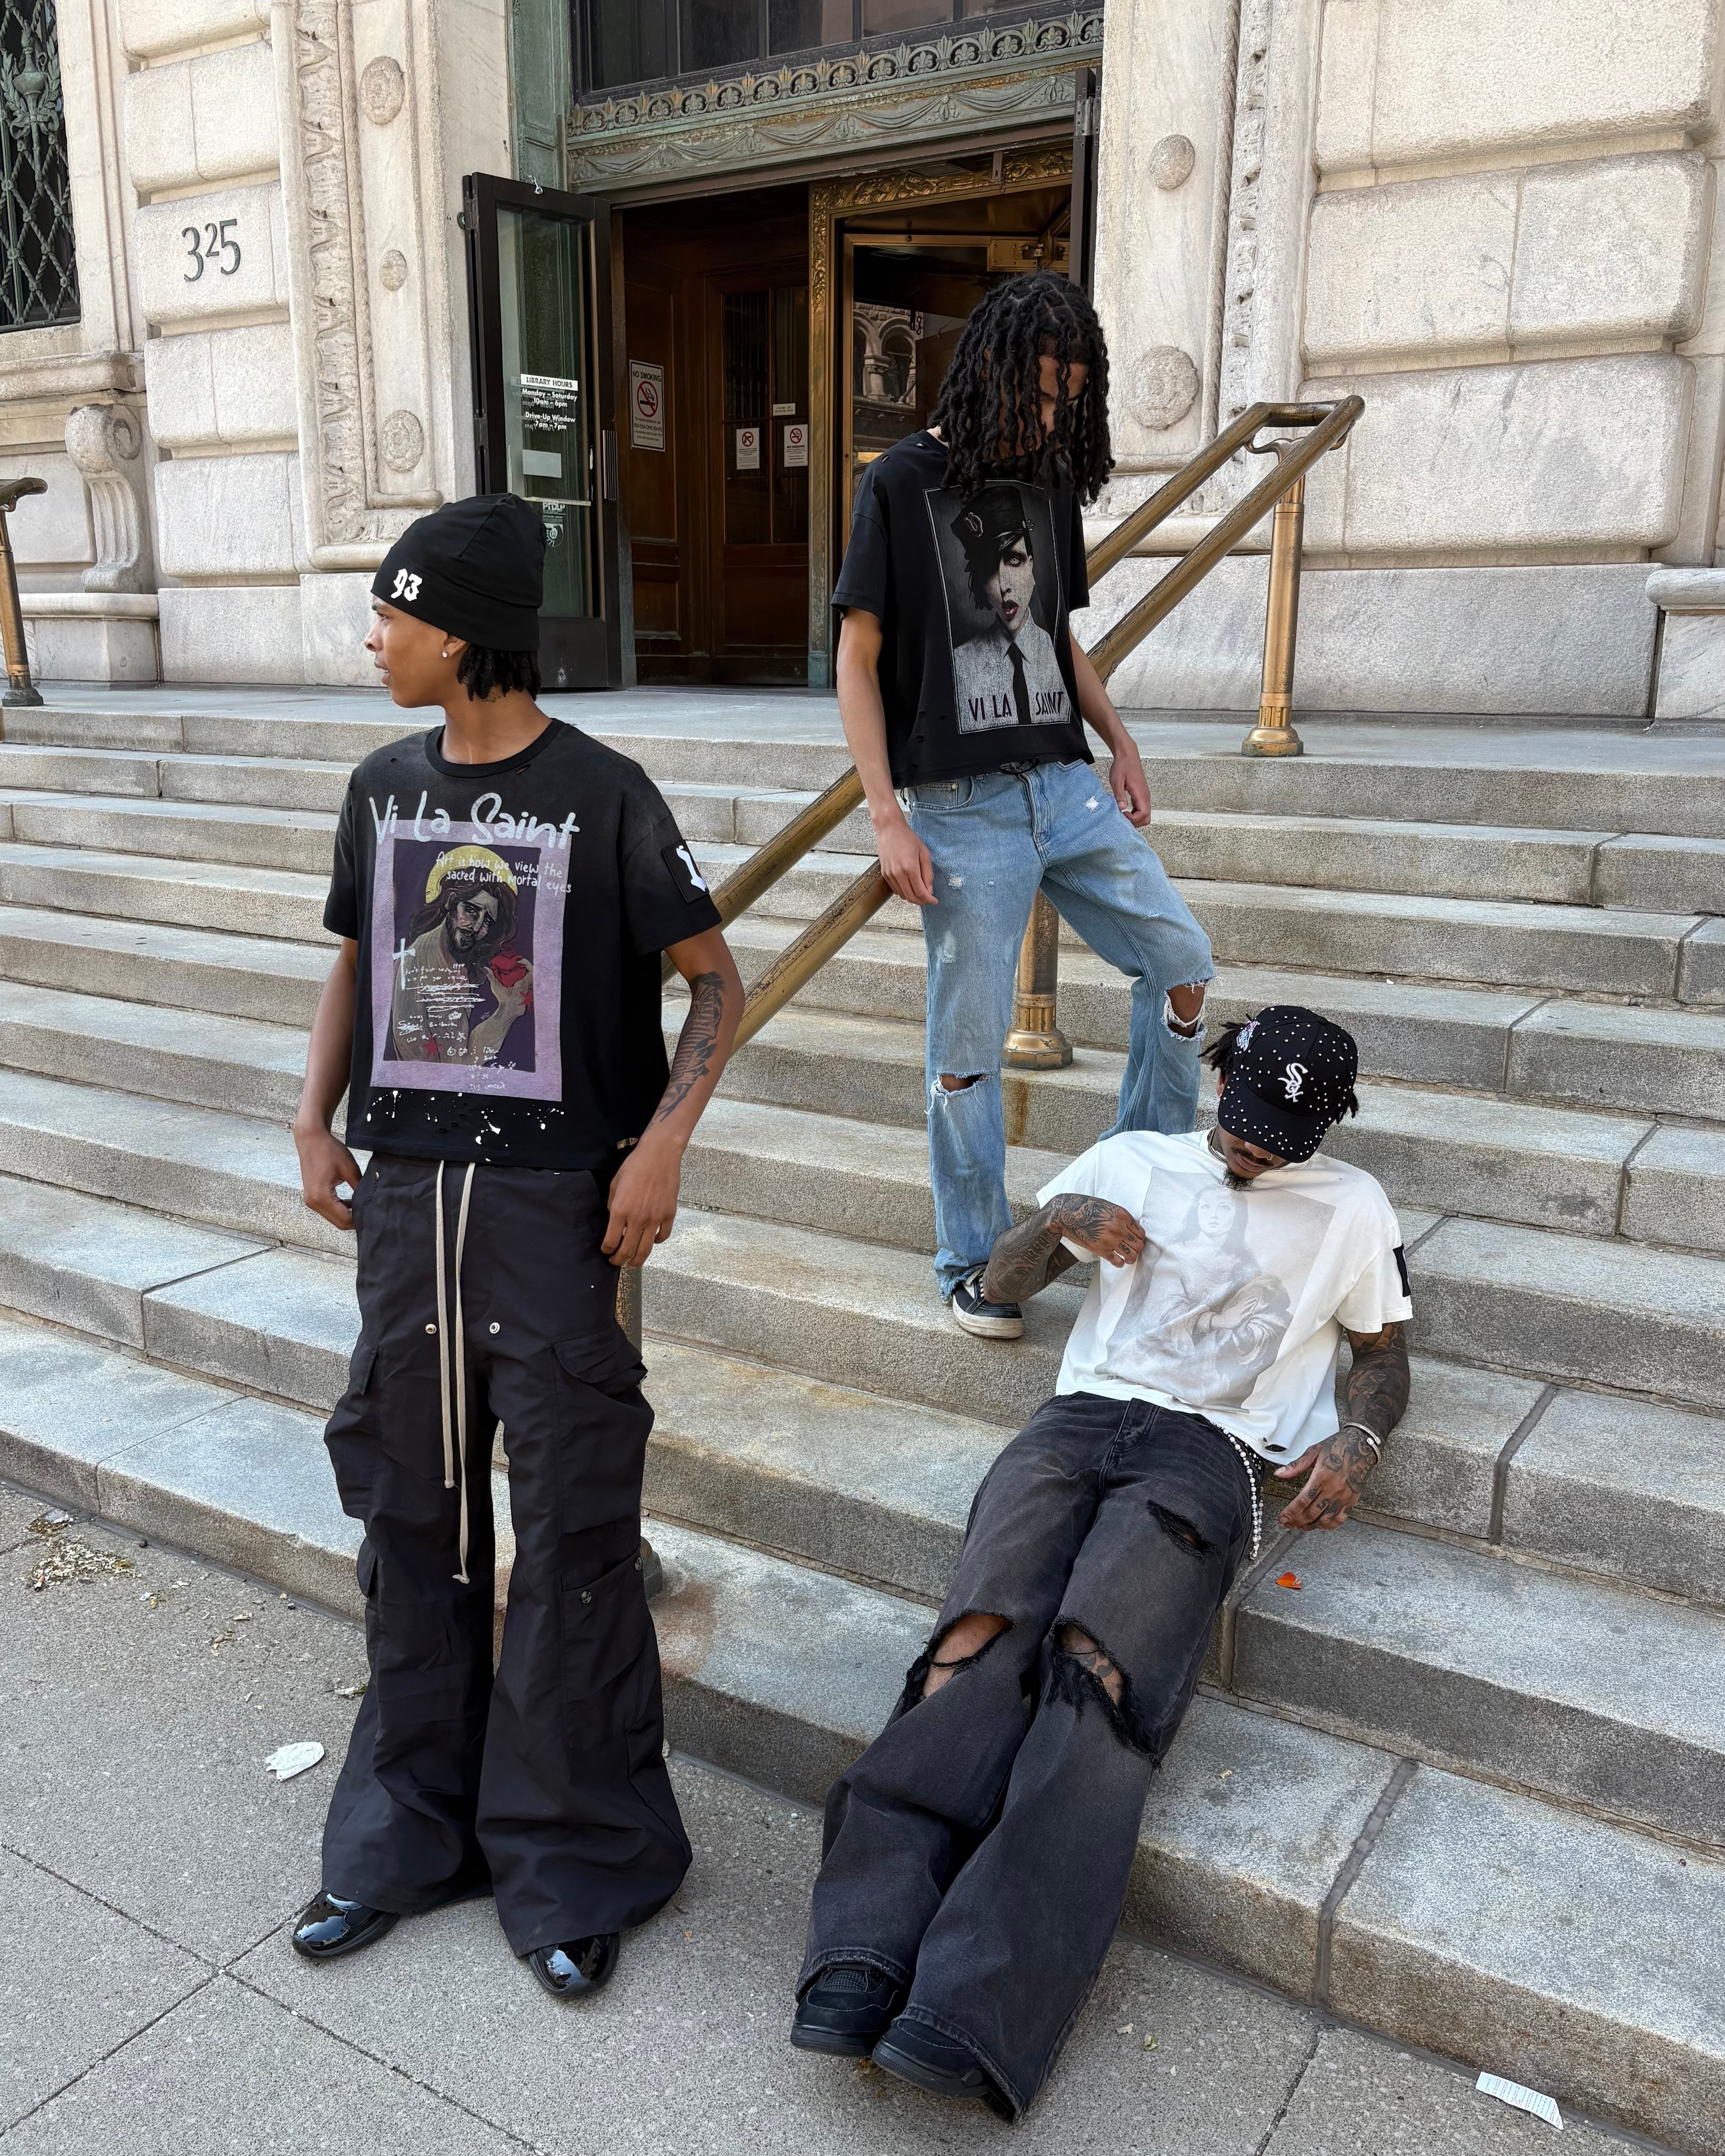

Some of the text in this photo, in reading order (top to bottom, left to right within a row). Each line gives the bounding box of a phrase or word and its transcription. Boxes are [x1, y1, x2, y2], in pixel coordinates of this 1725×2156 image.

[182, 218, 241, 282] 325
[526, 377, 550, 385] LIBRARY
[640, 372, 661, 382] SMOKING
[522, 388, 546, 398] Monday
[552, 392, 577, 402] Saturday
[525, 412, 576, 423] Drive-Up Window
[391, 568, 423, 601] 93
[968, 692, 1064, 721] VI LA SAINT
[369, 790, 580, 849] Vi La Saint
[436, 851, 563, 878] Art is how we view the
[445, 868, 476, 882] sacred
[507, 874, 542, 890] mortal
[546, 882, 571, 896] eyes
